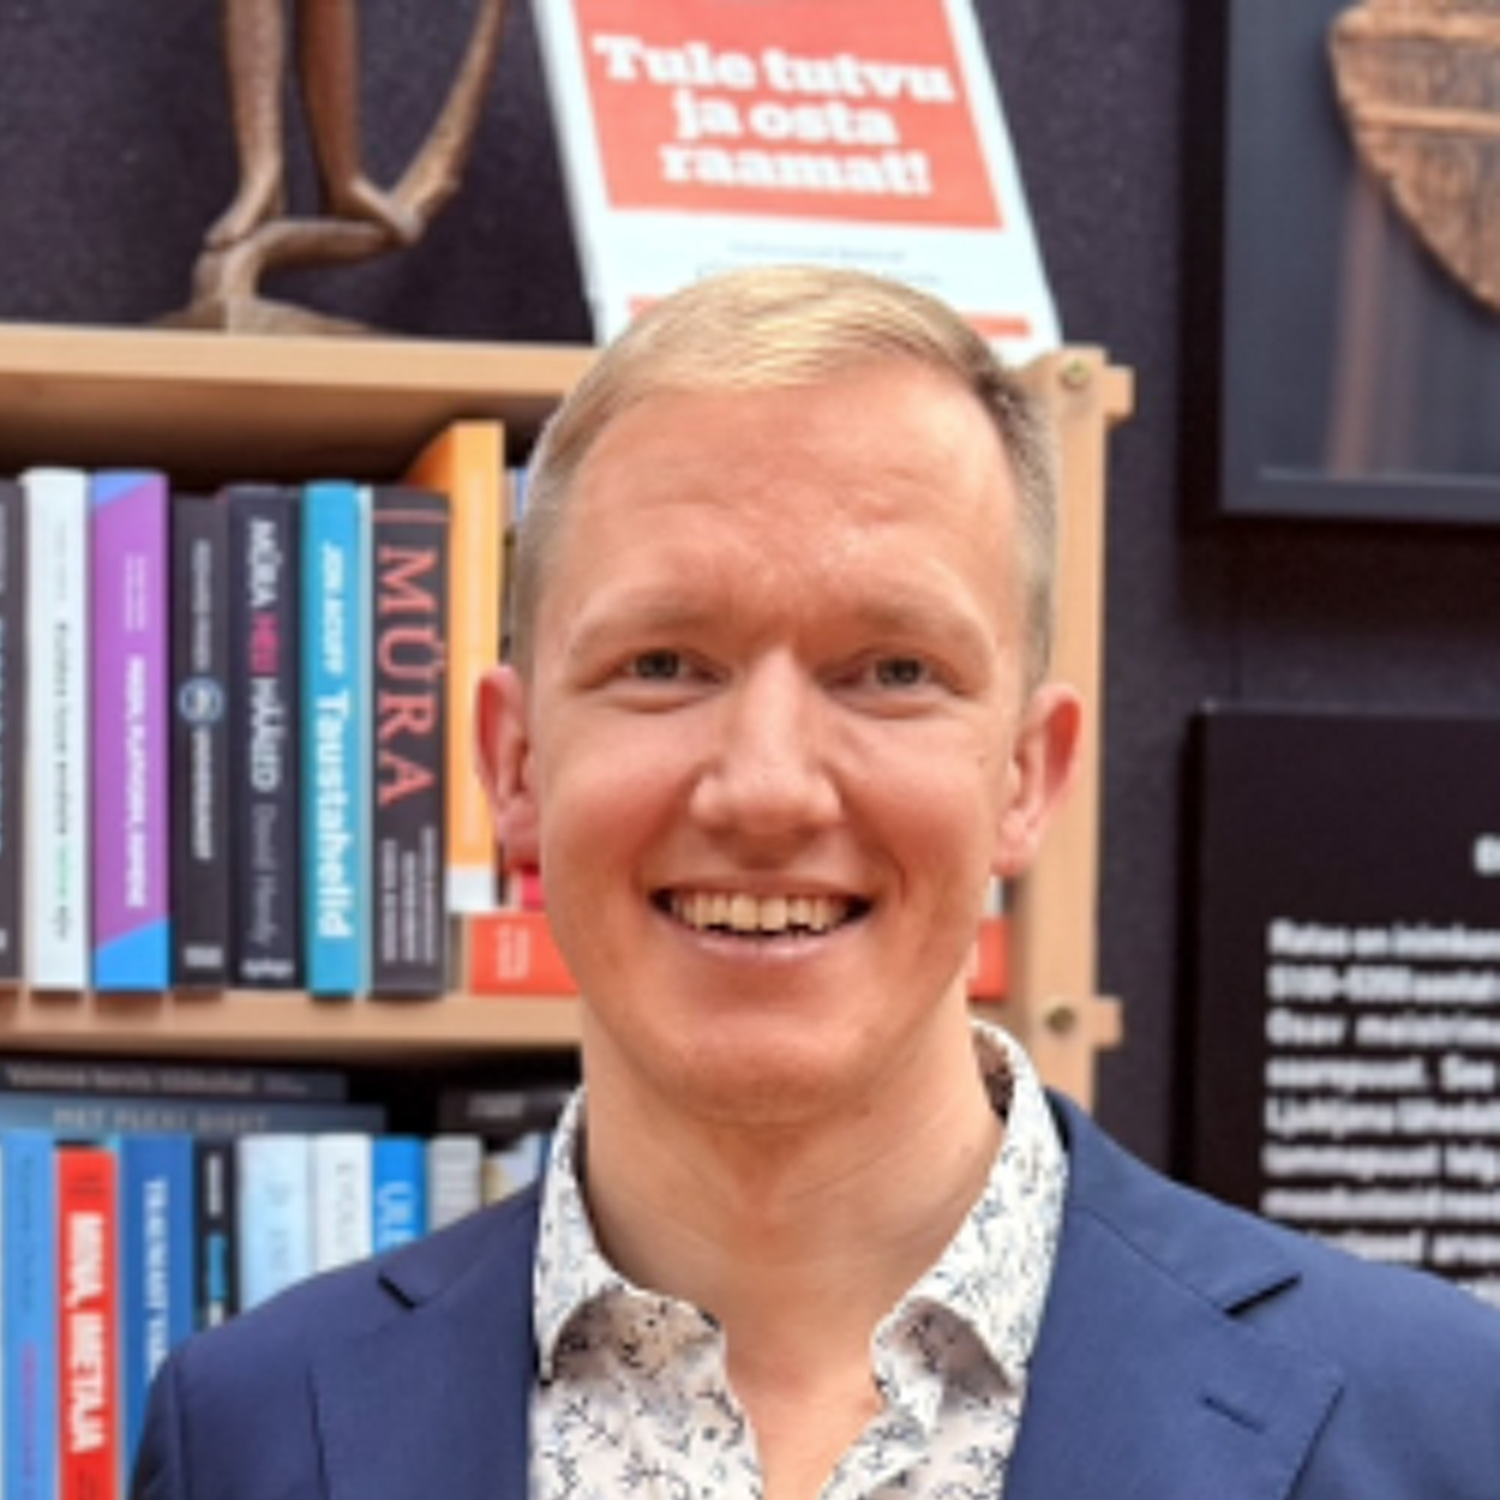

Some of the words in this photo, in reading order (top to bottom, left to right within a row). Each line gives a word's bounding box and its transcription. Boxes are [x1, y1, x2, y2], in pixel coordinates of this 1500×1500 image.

[593, 35, 756, 89] Tule
[762, 47, 956, 101] tutvu
[673, 89, 742, 140] ja
[751, 100, 898, 145] osta
[659, 144, 932, 195] raamat!
[247, 518, 285, 607] MÜRA
[379, 545, 445, 807] MÜRA
[247, 677, 288, 792] HÄÄLED
[316, 691, 355, 938] Taustahelid
[68, 1312, 105, 1454] IMETAJA
